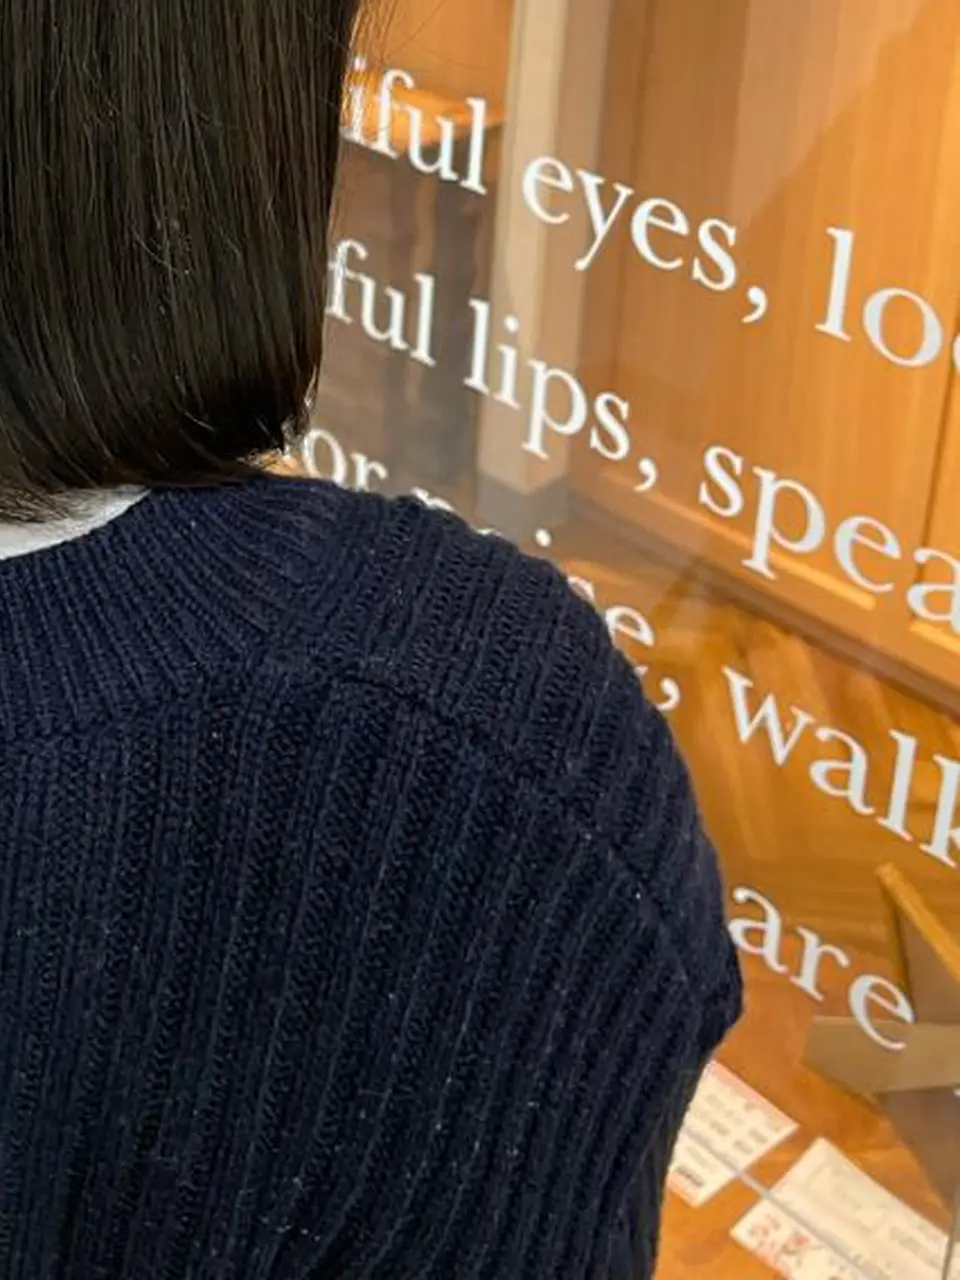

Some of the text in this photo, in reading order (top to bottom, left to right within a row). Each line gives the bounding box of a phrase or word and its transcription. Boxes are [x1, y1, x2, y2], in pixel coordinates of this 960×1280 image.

[522, 154, 767, 324] eyes,
[815, 227, 960, 368] lo
[463, 297, 658, 491] lips,
[727, 887, 916, 1051] are
